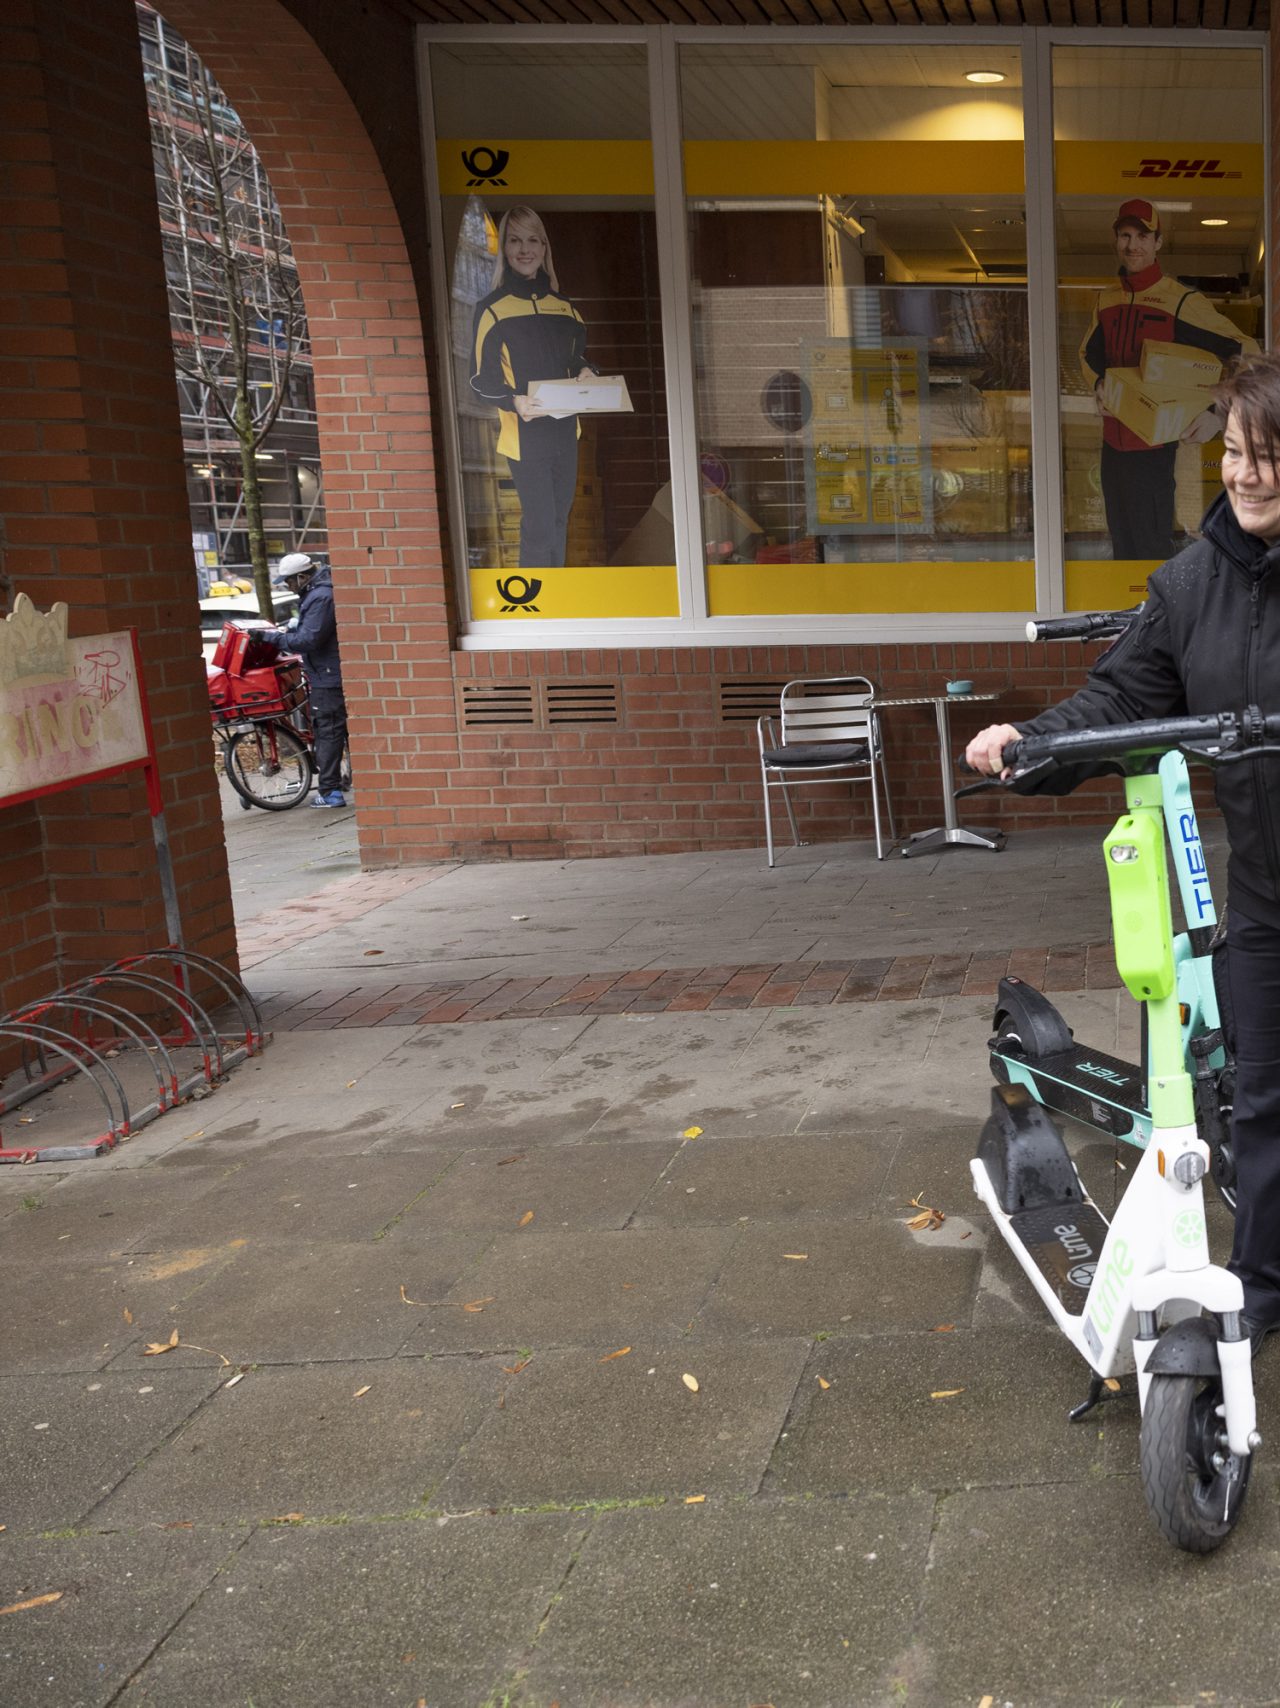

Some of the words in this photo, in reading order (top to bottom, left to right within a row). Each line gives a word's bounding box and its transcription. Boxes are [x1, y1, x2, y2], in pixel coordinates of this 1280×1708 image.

[1138, 159, 1226, 178] DHL
[1179, 813, 1213, 919] TIER
[1075, 1061, 1130, 1087] TIER
[1053, 1224, 1093, 1260] Lime
[1089, 1237, 1135, 1334] Lime
